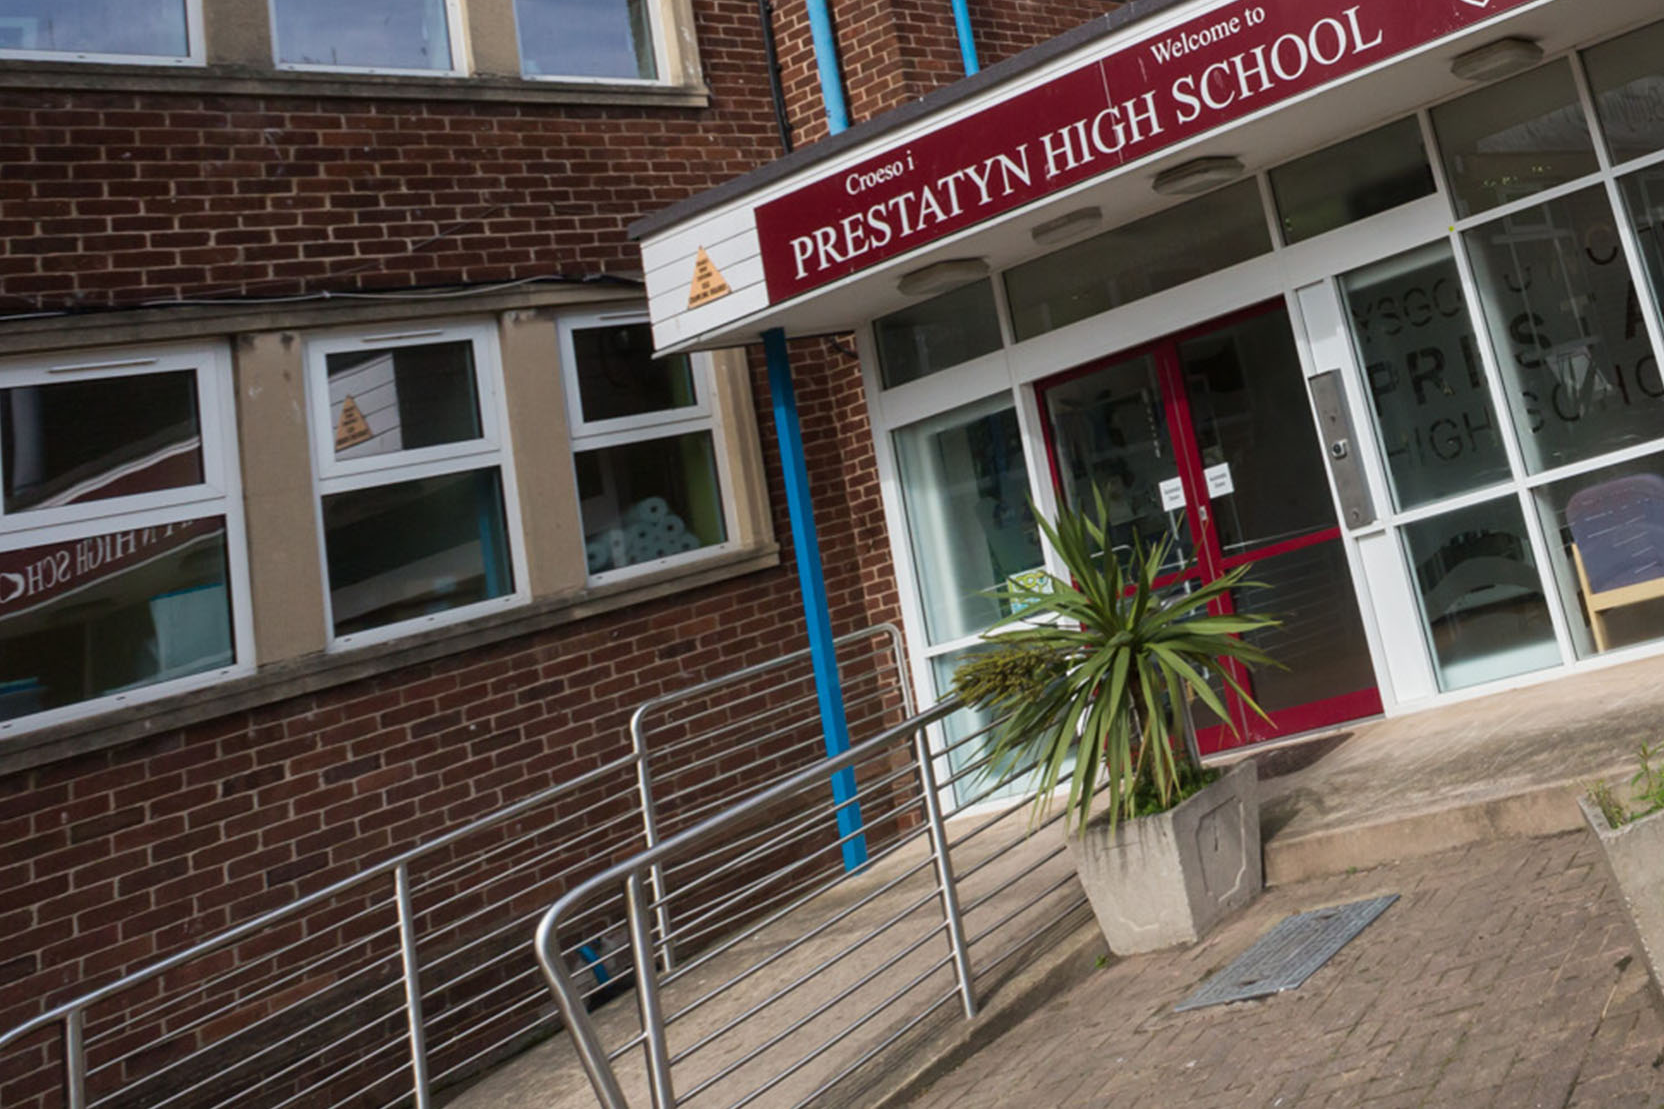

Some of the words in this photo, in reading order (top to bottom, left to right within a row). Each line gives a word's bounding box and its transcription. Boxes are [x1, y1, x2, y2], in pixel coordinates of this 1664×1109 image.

[1150, 14, 1241, 66] Welcome
[1244, 5, 1266, 28] to
[790, 145, 1031, 280] PRESTATYN
[1040, 91, 1164, 180] HIGH
[1172, 6, 1383, 125] SCHOOL
[846, 157, 905, 196] Croeso
[907, 149, 915, 172] i
